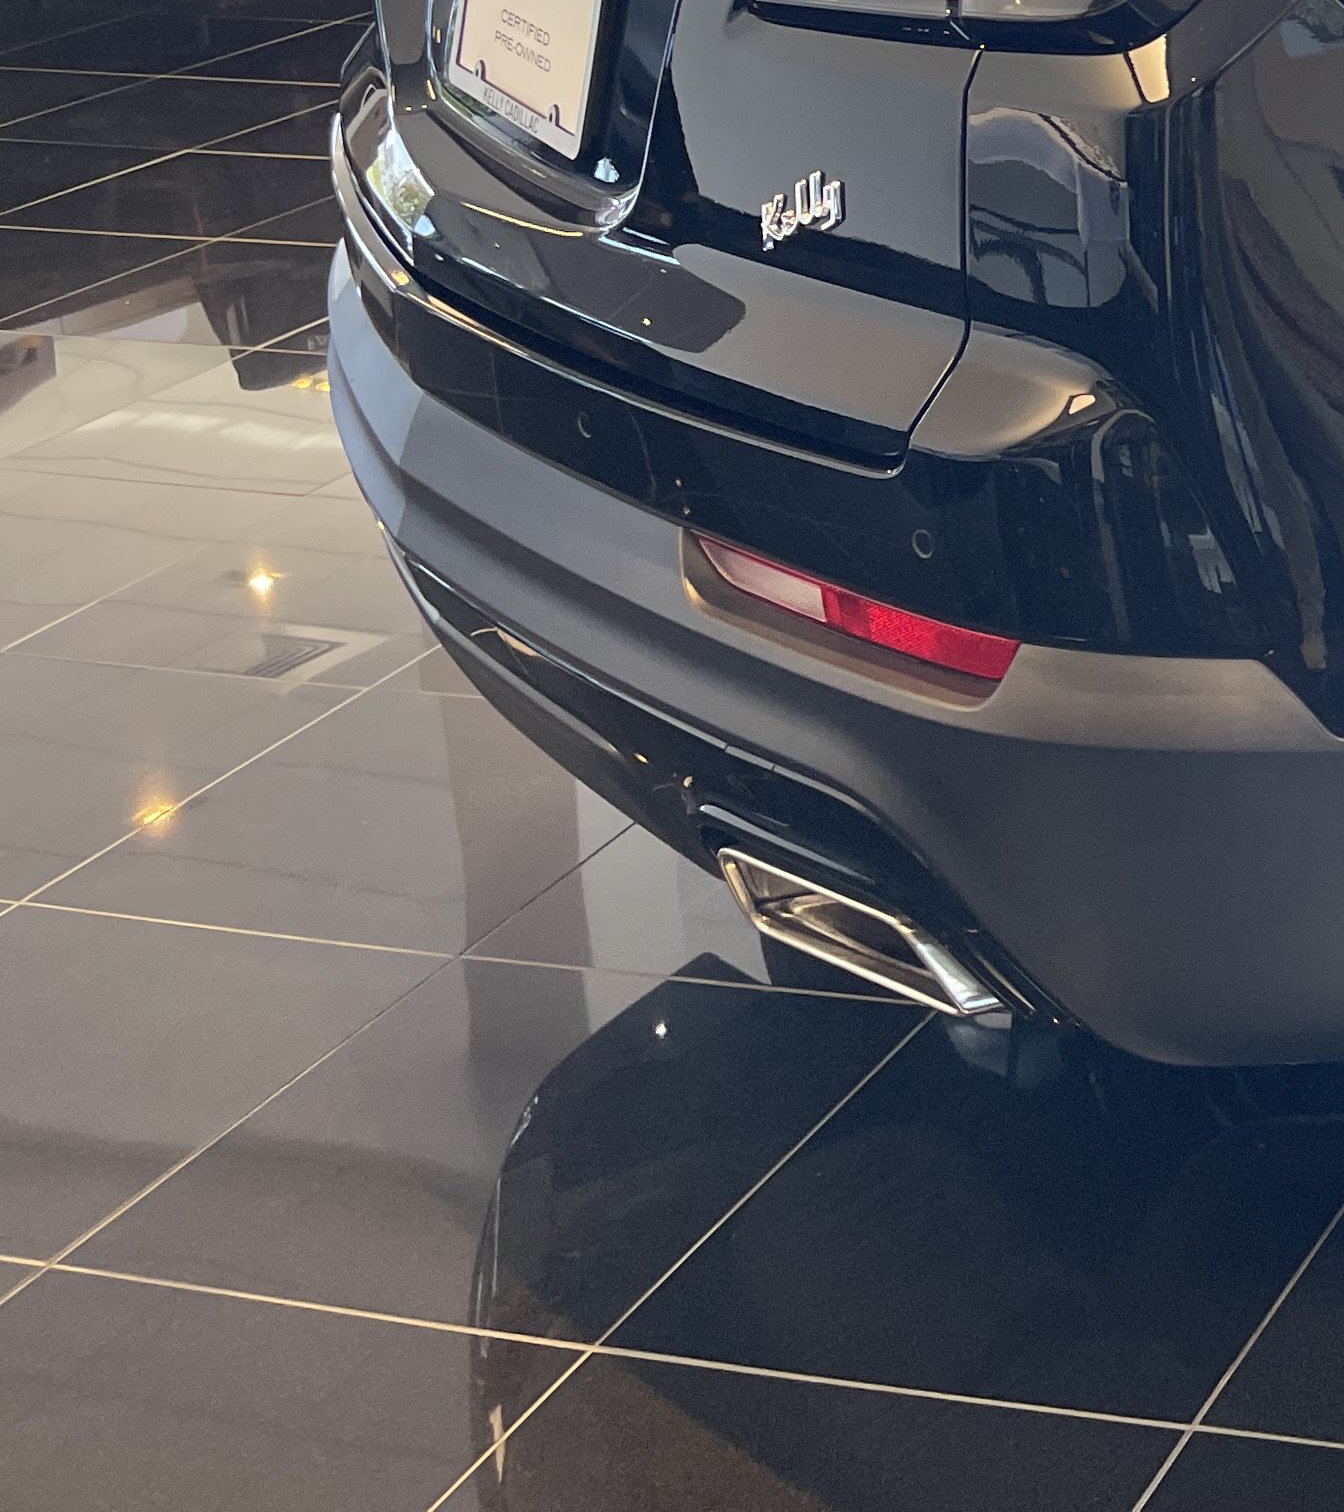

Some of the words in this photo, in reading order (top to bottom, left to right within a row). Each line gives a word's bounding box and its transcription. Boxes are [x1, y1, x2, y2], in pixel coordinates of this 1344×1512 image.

[500, 8, 551, 47] CERTIFIED
[494, 30, 551, 73] PRE-OWNED
[482, 86, 507, 112] KELLY
[503, 100, 541, 135] CADILLAC
[761, 170, 845, 251] Kelly
